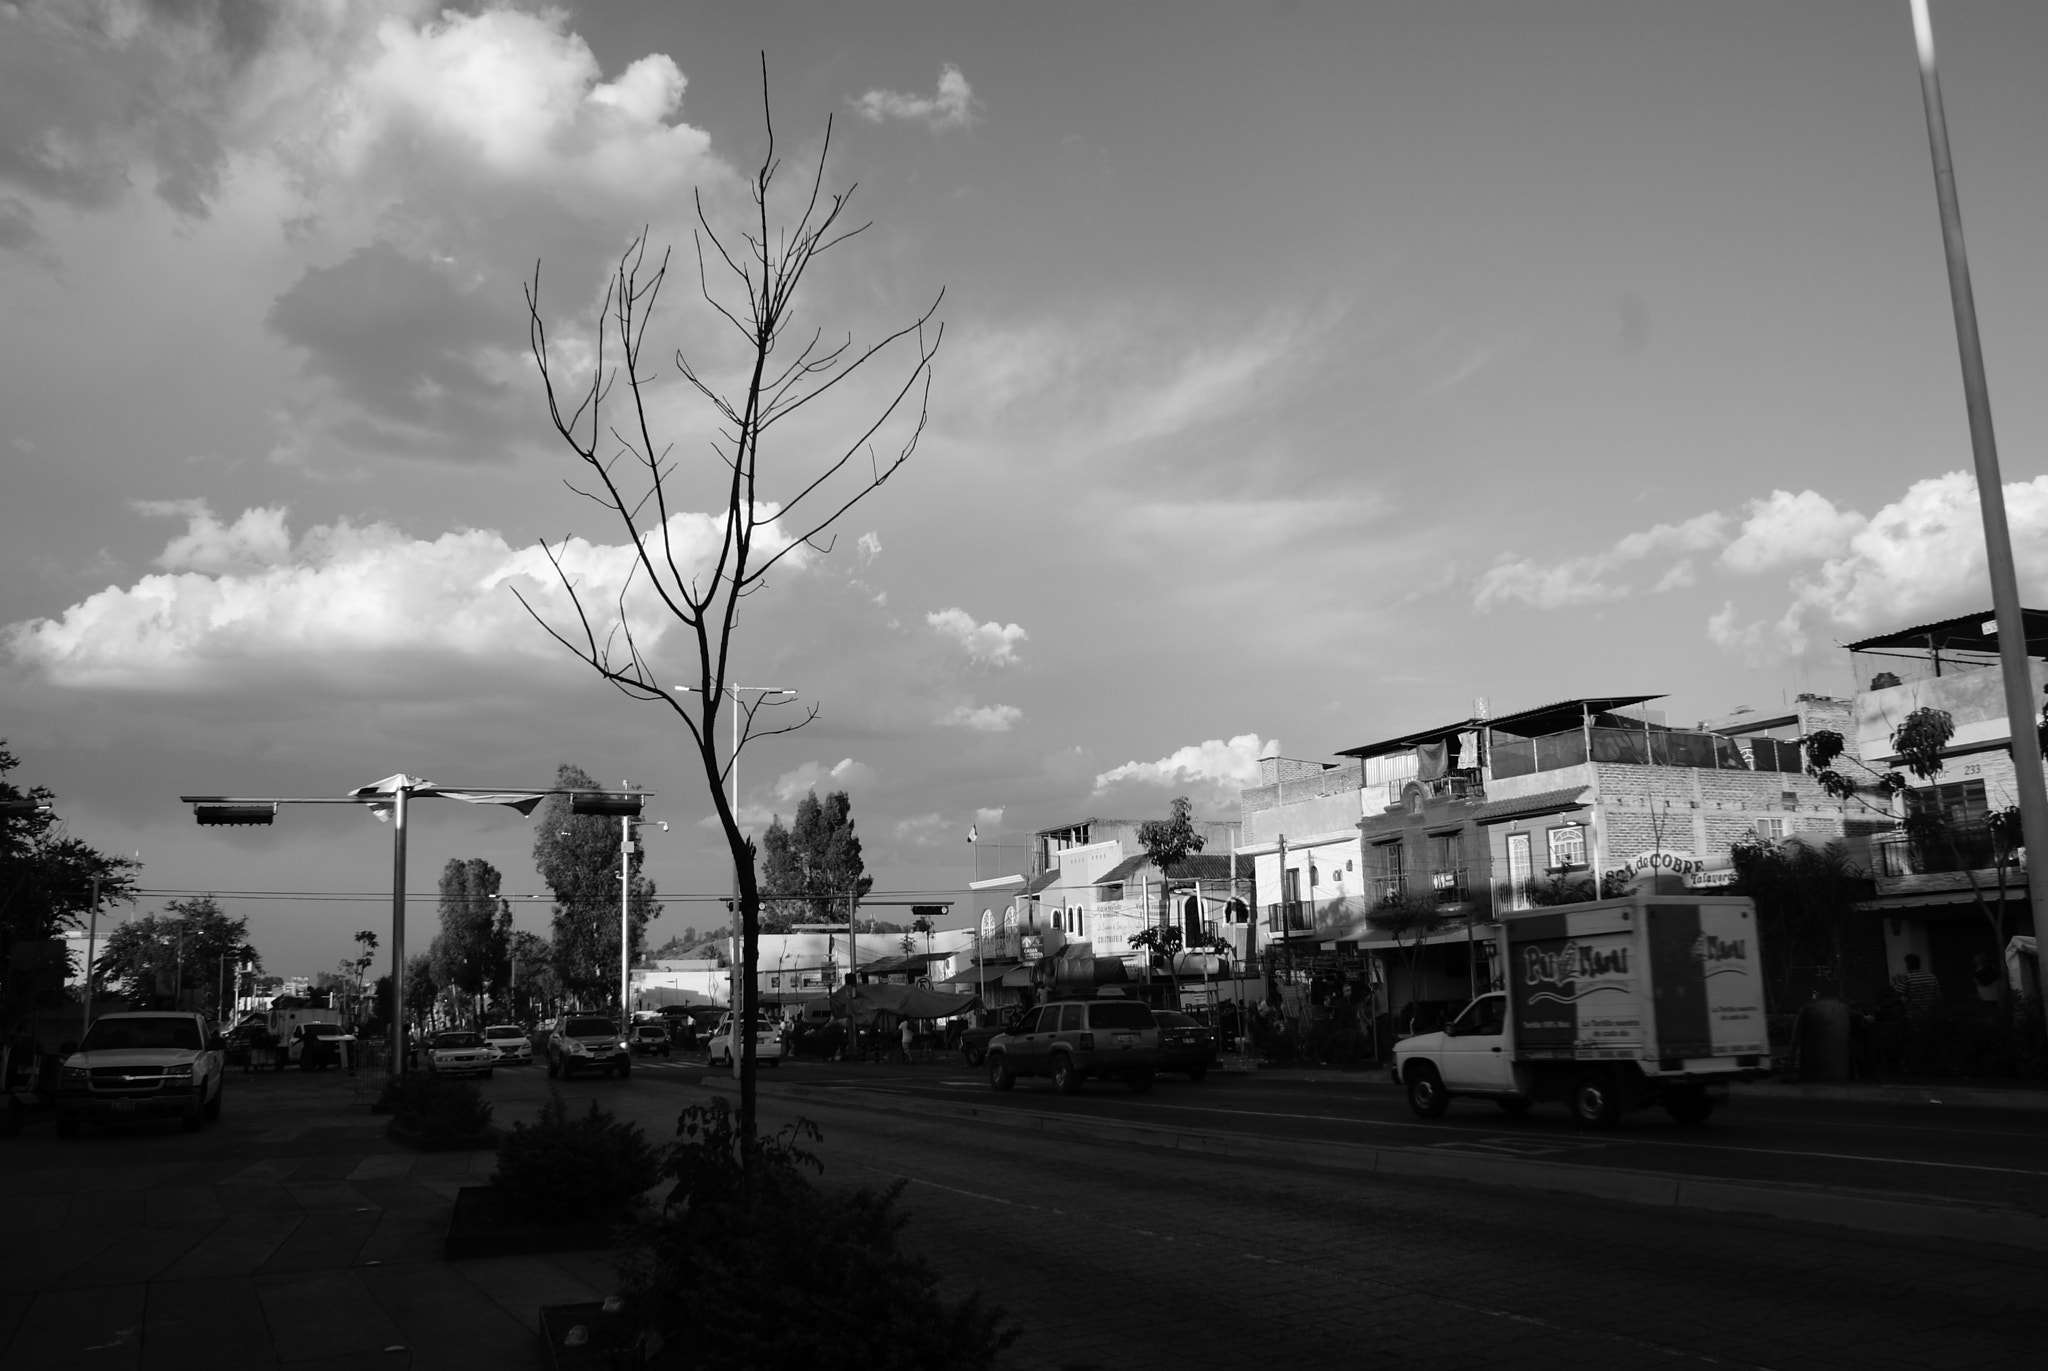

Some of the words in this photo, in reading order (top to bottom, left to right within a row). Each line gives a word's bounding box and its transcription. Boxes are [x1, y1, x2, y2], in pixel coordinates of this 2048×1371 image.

[1964, 764, 1981, 775] 233
[1637, 856, 1649, 870] de
[1650, 853, 1704, 874] COBRE
